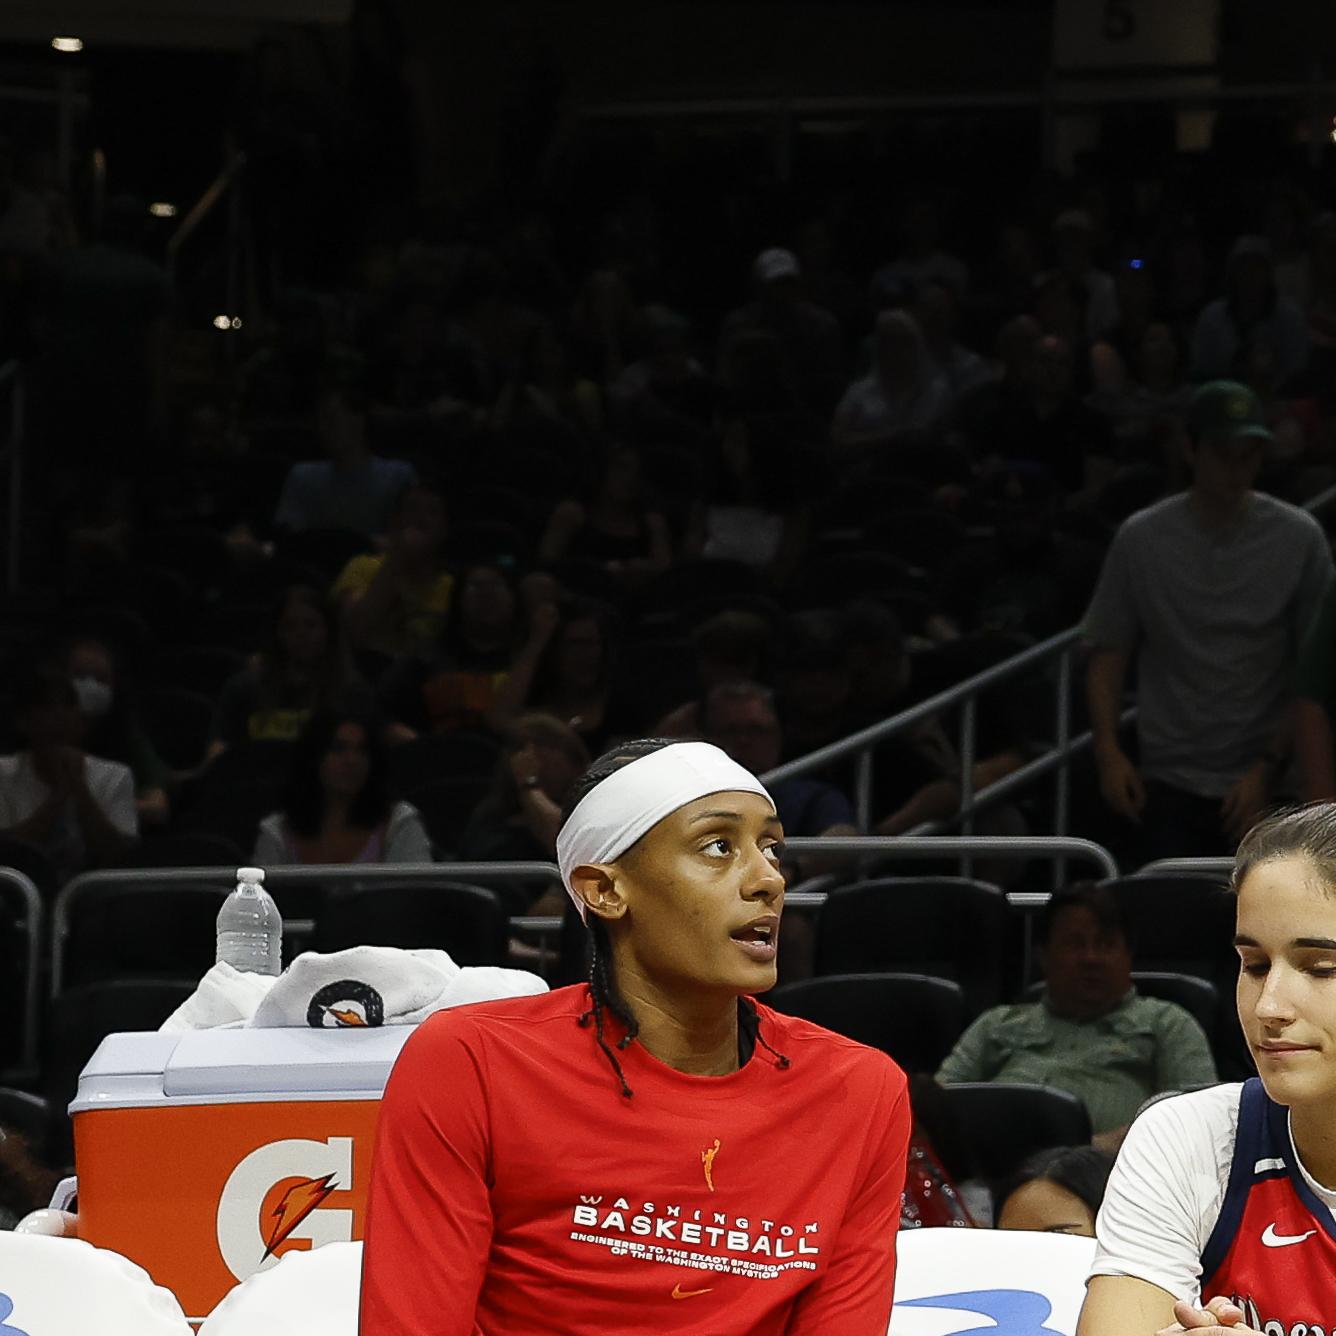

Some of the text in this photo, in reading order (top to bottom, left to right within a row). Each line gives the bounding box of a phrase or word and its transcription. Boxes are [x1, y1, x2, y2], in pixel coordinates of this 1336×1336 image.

[216, 1136, 353, 1284] G
[579, 1194, 819, 1236] WASHINGTON
[570, 1231, 645, 1251] ENGINEERED
[648, 1245, 664, 1254] TO
[666, 1248, 688, 1259] THE
[690, 1252, 729, 1265] EXACT
[573, 1205, 819, 1258] BASKETBALL
[611, 1246, 628, 1255] OF
[631, 1250, 653, 1260] THE
[655, 1254, 731, 1273] WASHINGTON
